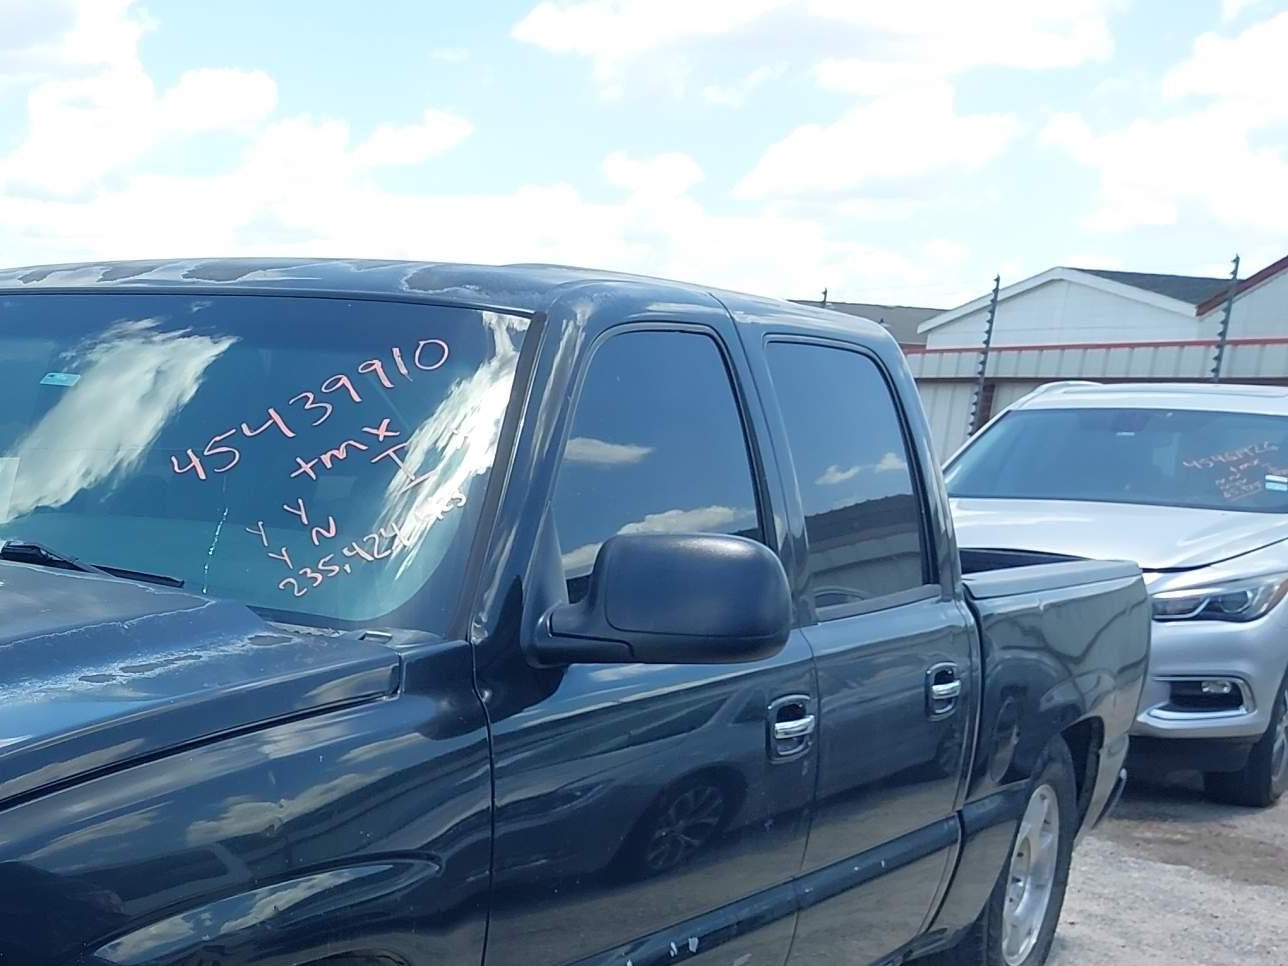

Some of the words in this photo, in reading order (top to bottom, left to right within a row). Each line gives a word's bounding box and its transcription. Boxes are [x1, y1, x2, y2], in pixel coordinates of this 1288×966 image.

[170, 338, 450, 480] 45439910
[244, 519, 268, 547] Y
[282, 497, 309, 525] Y
[267, 546, 293, 570] Y
[311, 515, 337, 546] N
